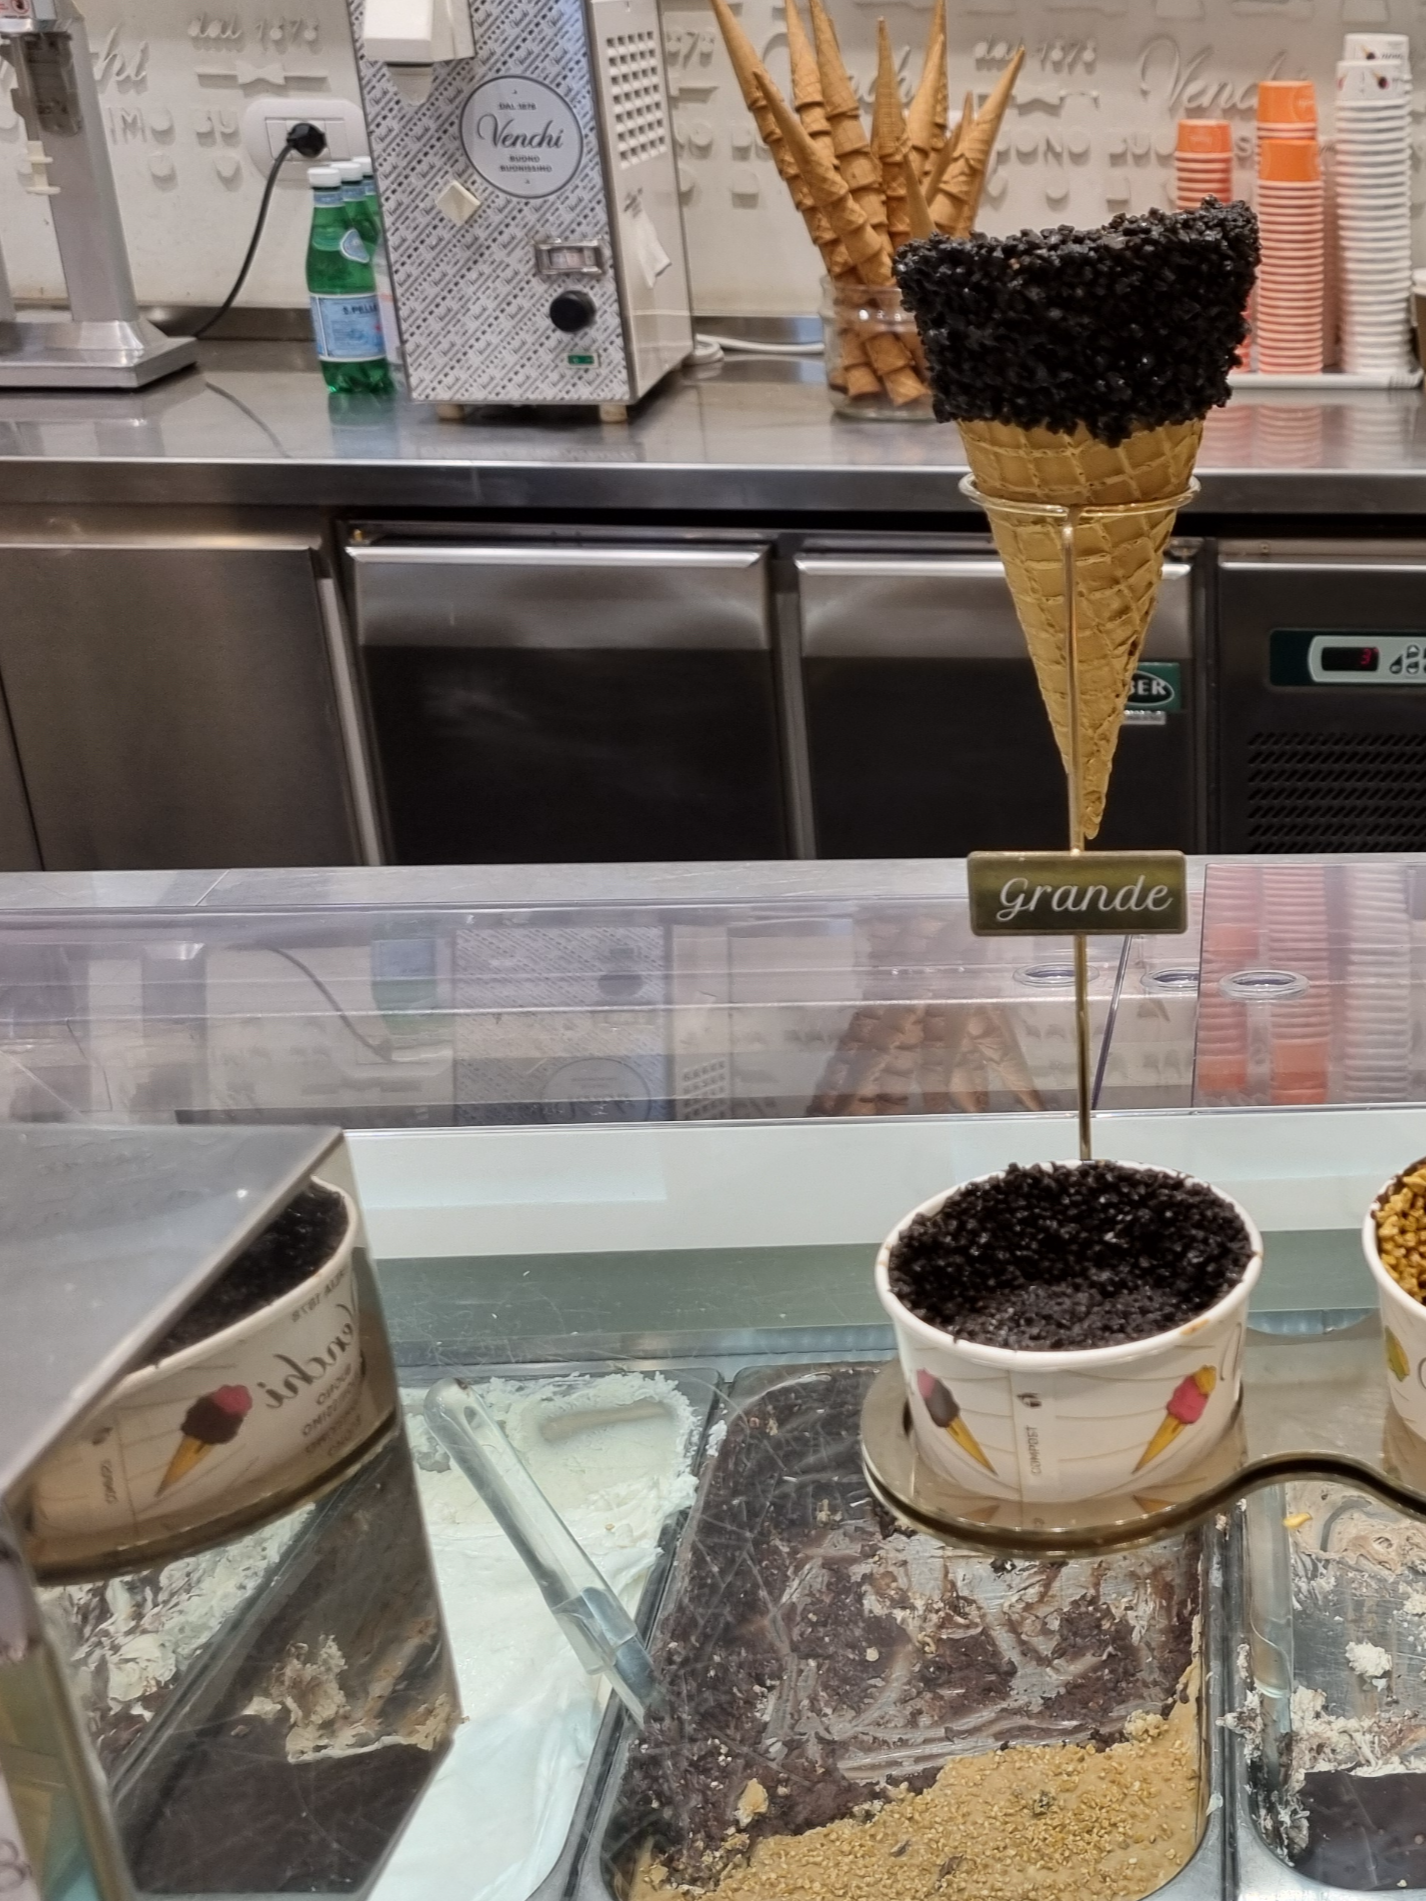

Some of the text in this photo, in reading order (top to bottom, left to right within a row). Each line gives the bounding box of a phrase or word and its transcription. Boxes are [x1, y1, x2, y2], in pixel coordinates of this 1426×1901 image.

[477, 112, 564, 149] Venchi
[509, 154, 541, 163] BUONO
[1129, 679, 1167, 696] BER
[996, 875, 1173, 921] Grande
